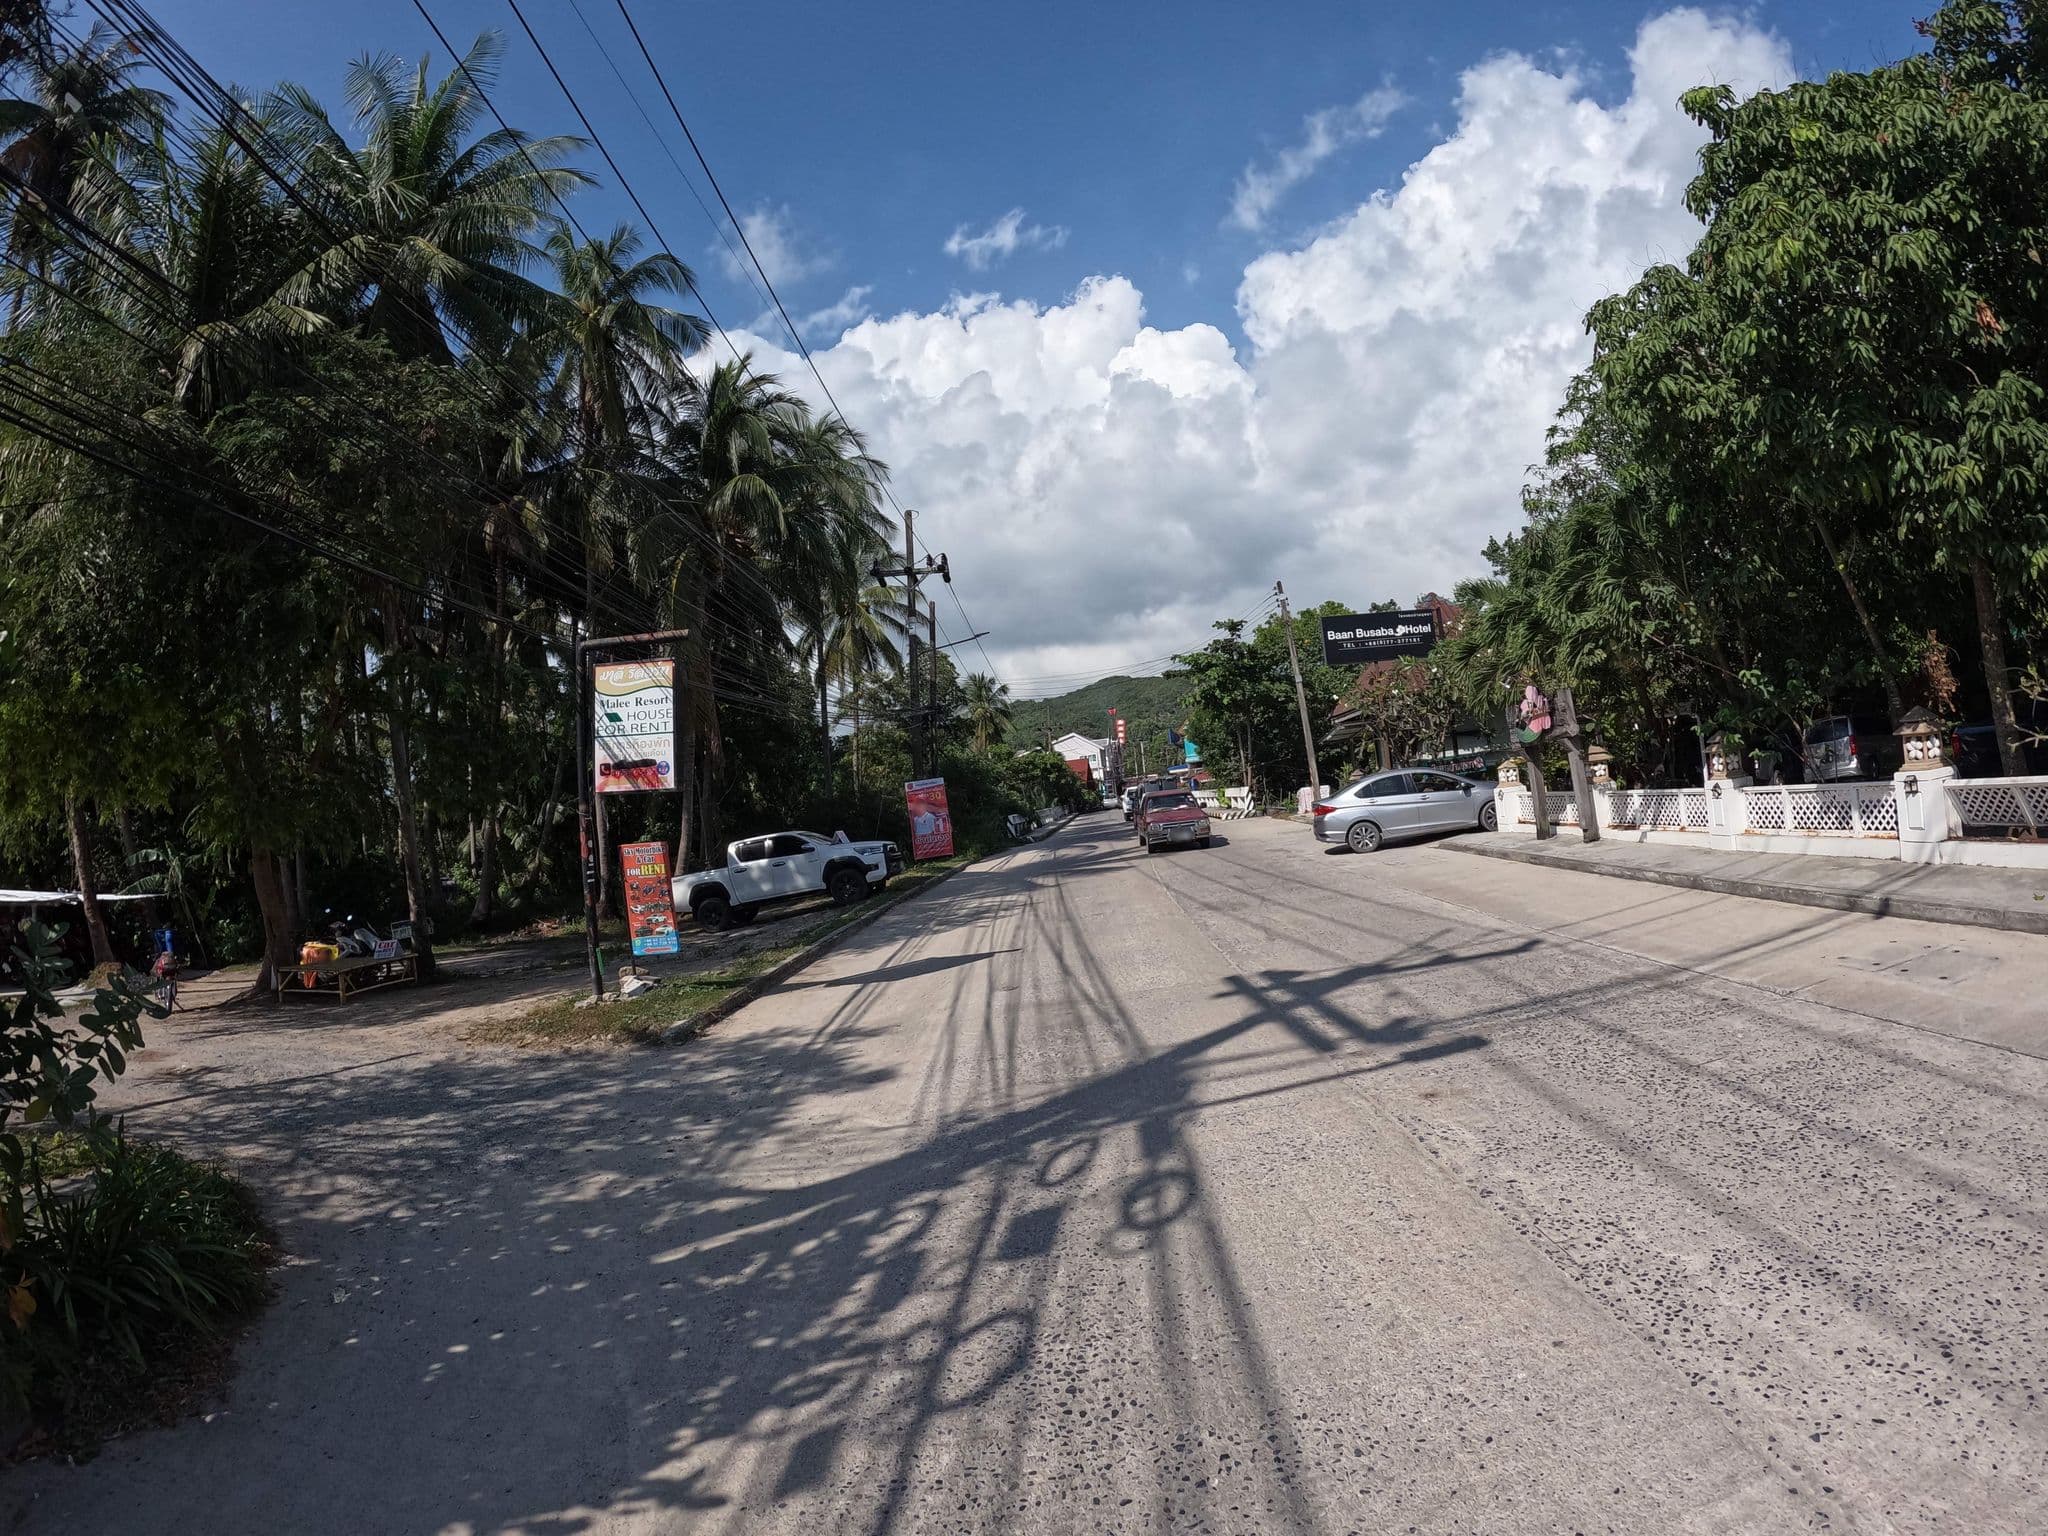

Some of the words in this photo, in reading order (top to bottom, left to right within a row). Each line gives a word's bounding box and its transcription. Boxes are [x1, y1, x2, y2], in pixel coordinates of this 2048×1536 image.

[1327, 630, 1354, 641] Baan
[1356, 626, 1394, 638] Busaba
[1405, 623, 1432, 634] Hotel
[600, 698, 631, 709] Malee
[635, 695, 669, 707] Resort
[627, 708, 673, 722] HOUSE
[597, 724, 626, 736] FOR
[630, 721, 671, 734] RENT
[626, 867, 641, 876] FOR
[640, 864, 666, 876] RENT
